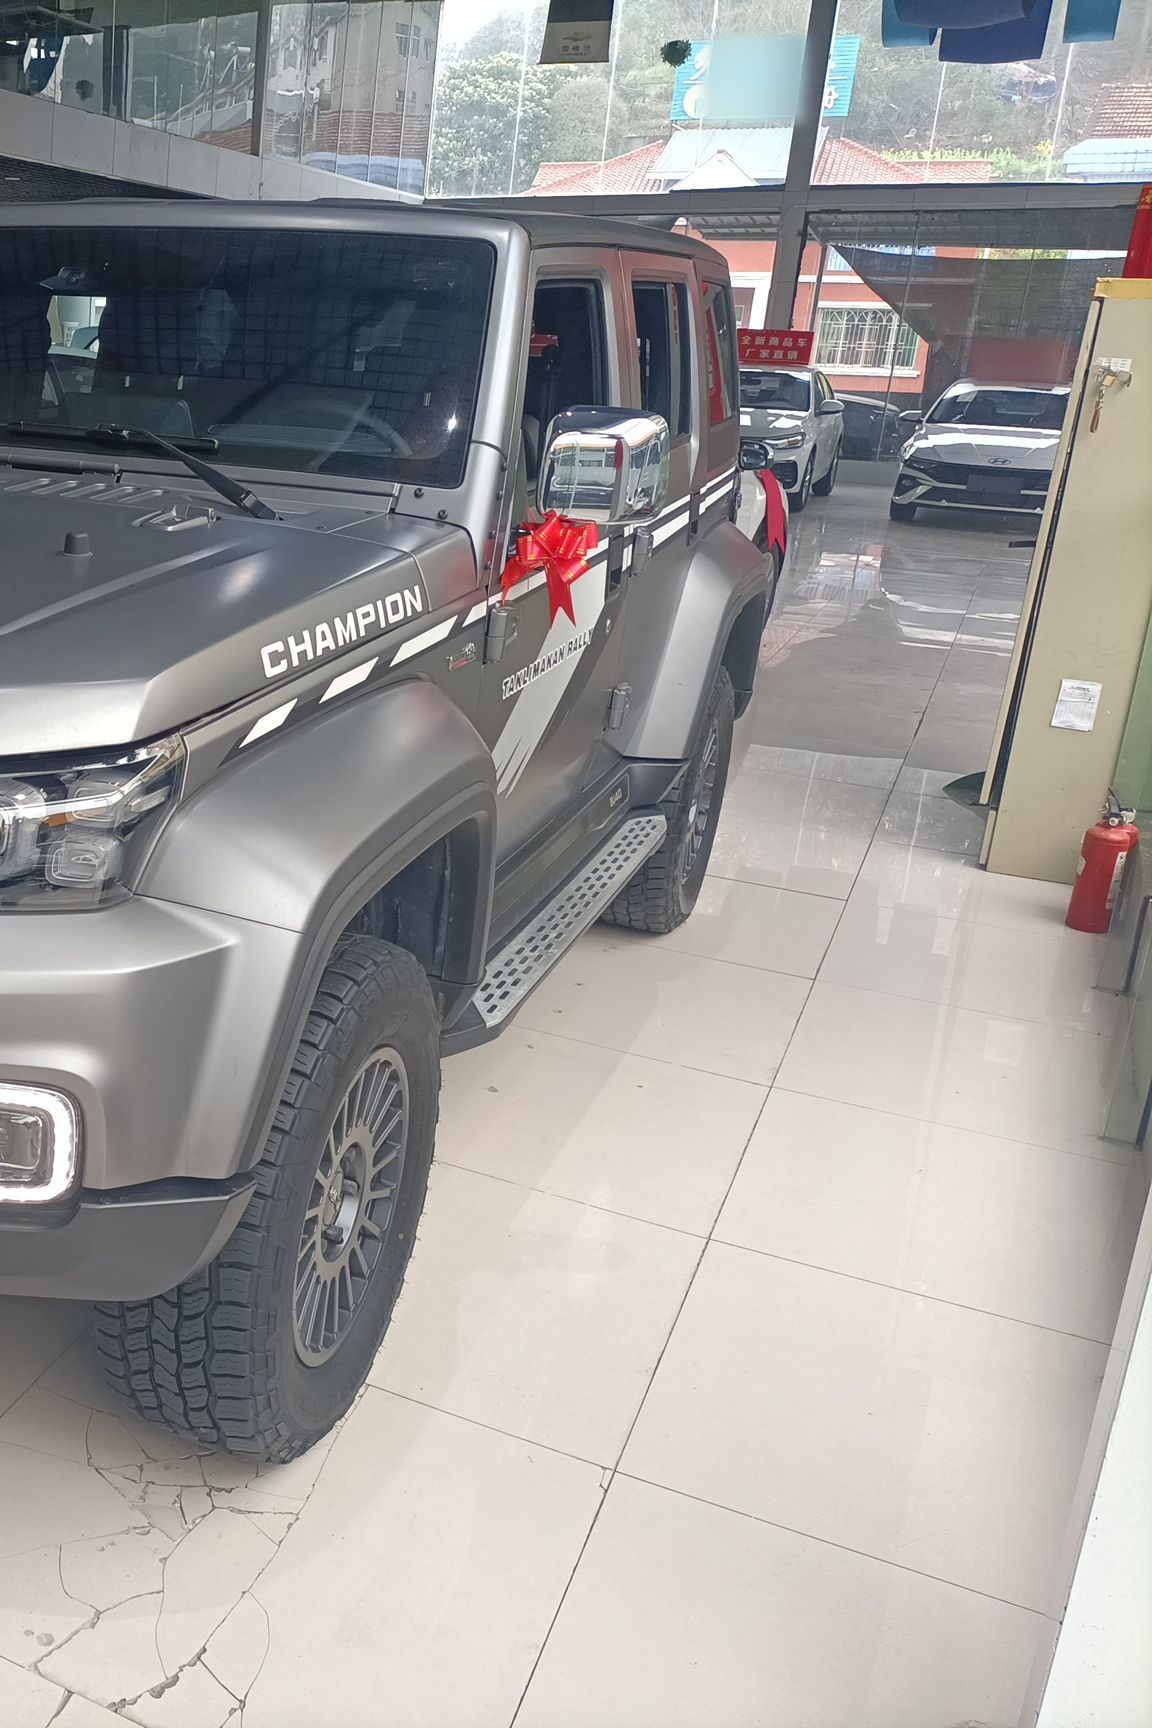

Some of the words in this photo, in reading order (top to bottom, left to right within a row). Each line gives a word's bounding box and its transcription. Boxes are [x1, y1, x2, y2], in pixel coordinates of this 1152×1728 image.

[740, 335, 808, 347] 全新商品车
[745, 348, 798, 360] 厂家直销
[260, 584, 424, 678] CHAMPION
[502, 643, 566, 700] TAKLIMAKAN
[566, 625, 595, 659] RALLY
